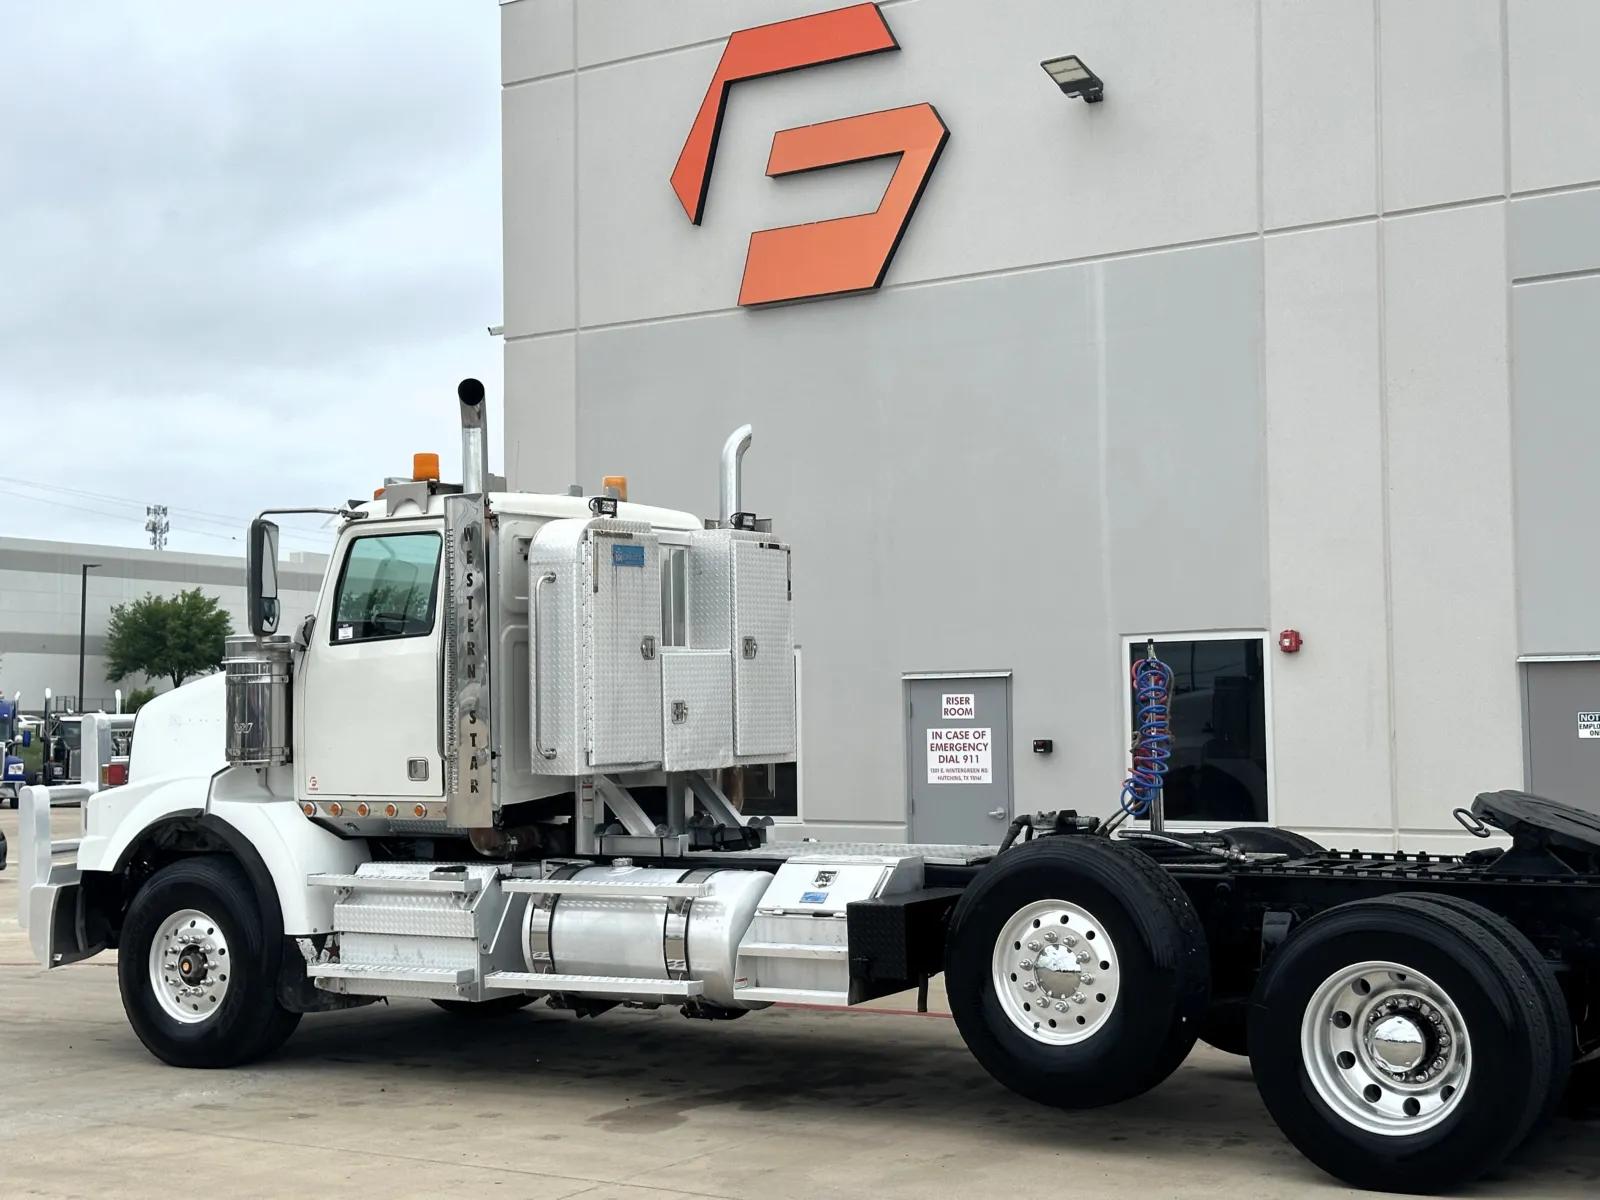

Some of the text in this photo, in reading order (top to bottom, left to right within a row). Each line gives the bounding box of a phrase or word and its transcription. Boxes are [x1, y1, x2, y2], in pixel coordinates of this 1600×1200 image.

[464, 527, 479, 793] WESTERN STAR
[946, 696, 970, 705] RISER
[944, 708, 973, 716] ROOM
[932, 730, 986, 740] IN CASE OF
[930, 742, 988, 751] EMERGENCY
[938, 754, 979, 764] DIAL 911
